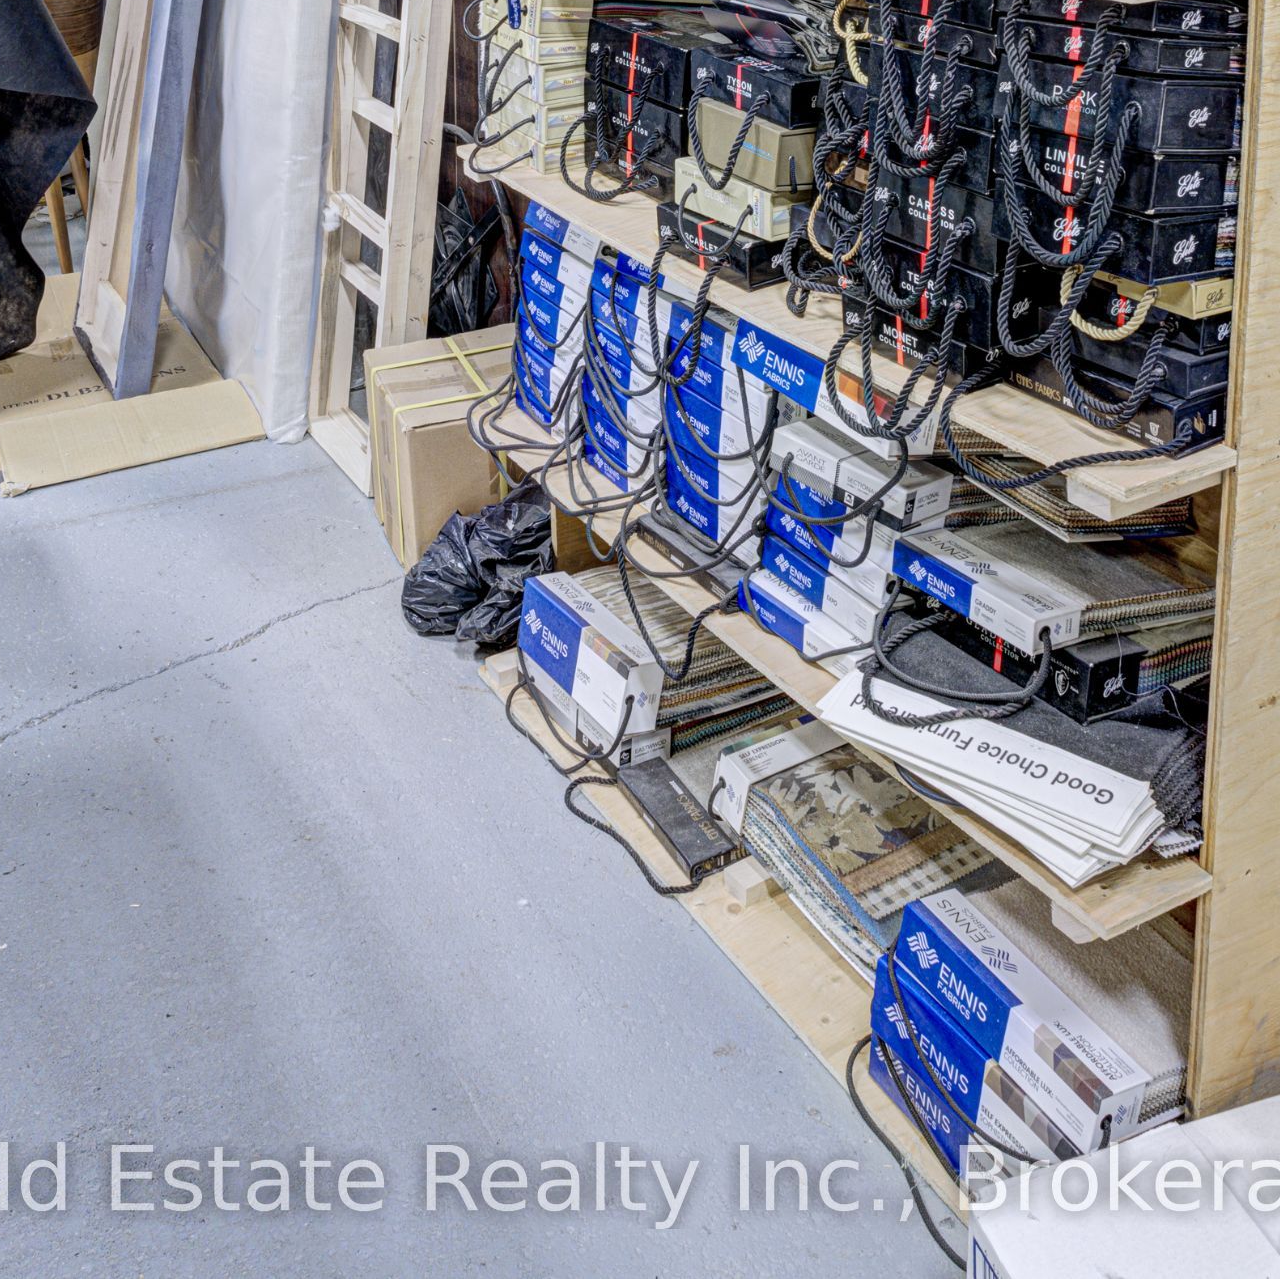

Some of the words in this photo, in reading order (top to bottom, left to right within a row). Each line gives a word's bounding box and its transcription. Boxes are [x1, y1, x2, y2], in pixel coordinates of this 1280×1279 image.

[1181, 9, 1205, 30] Elite
[1184, 47, 1207, 68] Elite
[727, 75, 752, 90] TYSON
[1188, 106, 1212, 128] Elite
[1045, 147, 1105, 173] LINVILE
[1044, 163, 1103, 185] COLLECTN
[1177, 170, 1205, 198] Elite
[908, 195, 955, 220] CARSS
[908, 207, 955, 231] COLLEION
[1053, 217, 1085, 242] Elite
[538, 248, 553, 264] ENNIS
[1172, 234, 1199, 265] Elite
[540, 277, 556, 294] ENNIS
[536, 308, 551, 324] ENNIS
[1110, 298, 1135, 316] Elite
[879, 335, 924, 360] COLLECTION
[883, 324, 918, 348] MONET
[606, 342, 622, 357] ENNIS
[152, 365, 187, 378] NS
[762, 368, 791, 391] FABRICS
[765, 349, 806, 387] ENNIS
[690, 416, 710, 436] ENNIS
[604, 431, 620, 449] ENNIS
[795, 454, 826, 472] GARDE
[796, 448, 826, 465] AVANT
[690, 470, 709, 490] ENNIS
[846, 475, 876, 494] SECTIONA
[689, 506, 709, 527] ENNIS
[795, 525, 818, 548] ENN
[922, 535, 969, 561] ENNIS
[550, 577, 578, 600] ENNIS
[789, 566, 812, 588] ENNIS
[927, 573, 956, 598] ENNIS
[926, 584, 947, 600] FABRICS
[540, 639, 560, 660] FABRICS
[541, 628, 568, 658] ENNIS
[980, 635, 1019, 661] COLLECTION
[888, 704, 974, 751] Furnire
[977, 744, 1047, 779] Choice
[1050, 774, 1114, 805] Good
[936, 899, 987, 944] ENNIS
[962, 907, 995, 939] FABRICS
[937, 982, 971, 1020] FABRICS
[939, 962, 987, 1023] ENNIS
[919, 1033, 969, 1095] ENNIS
[1004, 1045, 1040, 1086] AFFORDABLE
[1070, 1035, 1118, 1081] AFFORDABLE
[1076, 1034, 1124, 1079] COLLECTION
[1003, 1053, 1039, 1093] COLLECTION
[905, 1073, 951, 1134] ENNIS
[981, 1104, 995, 1120] SELF
